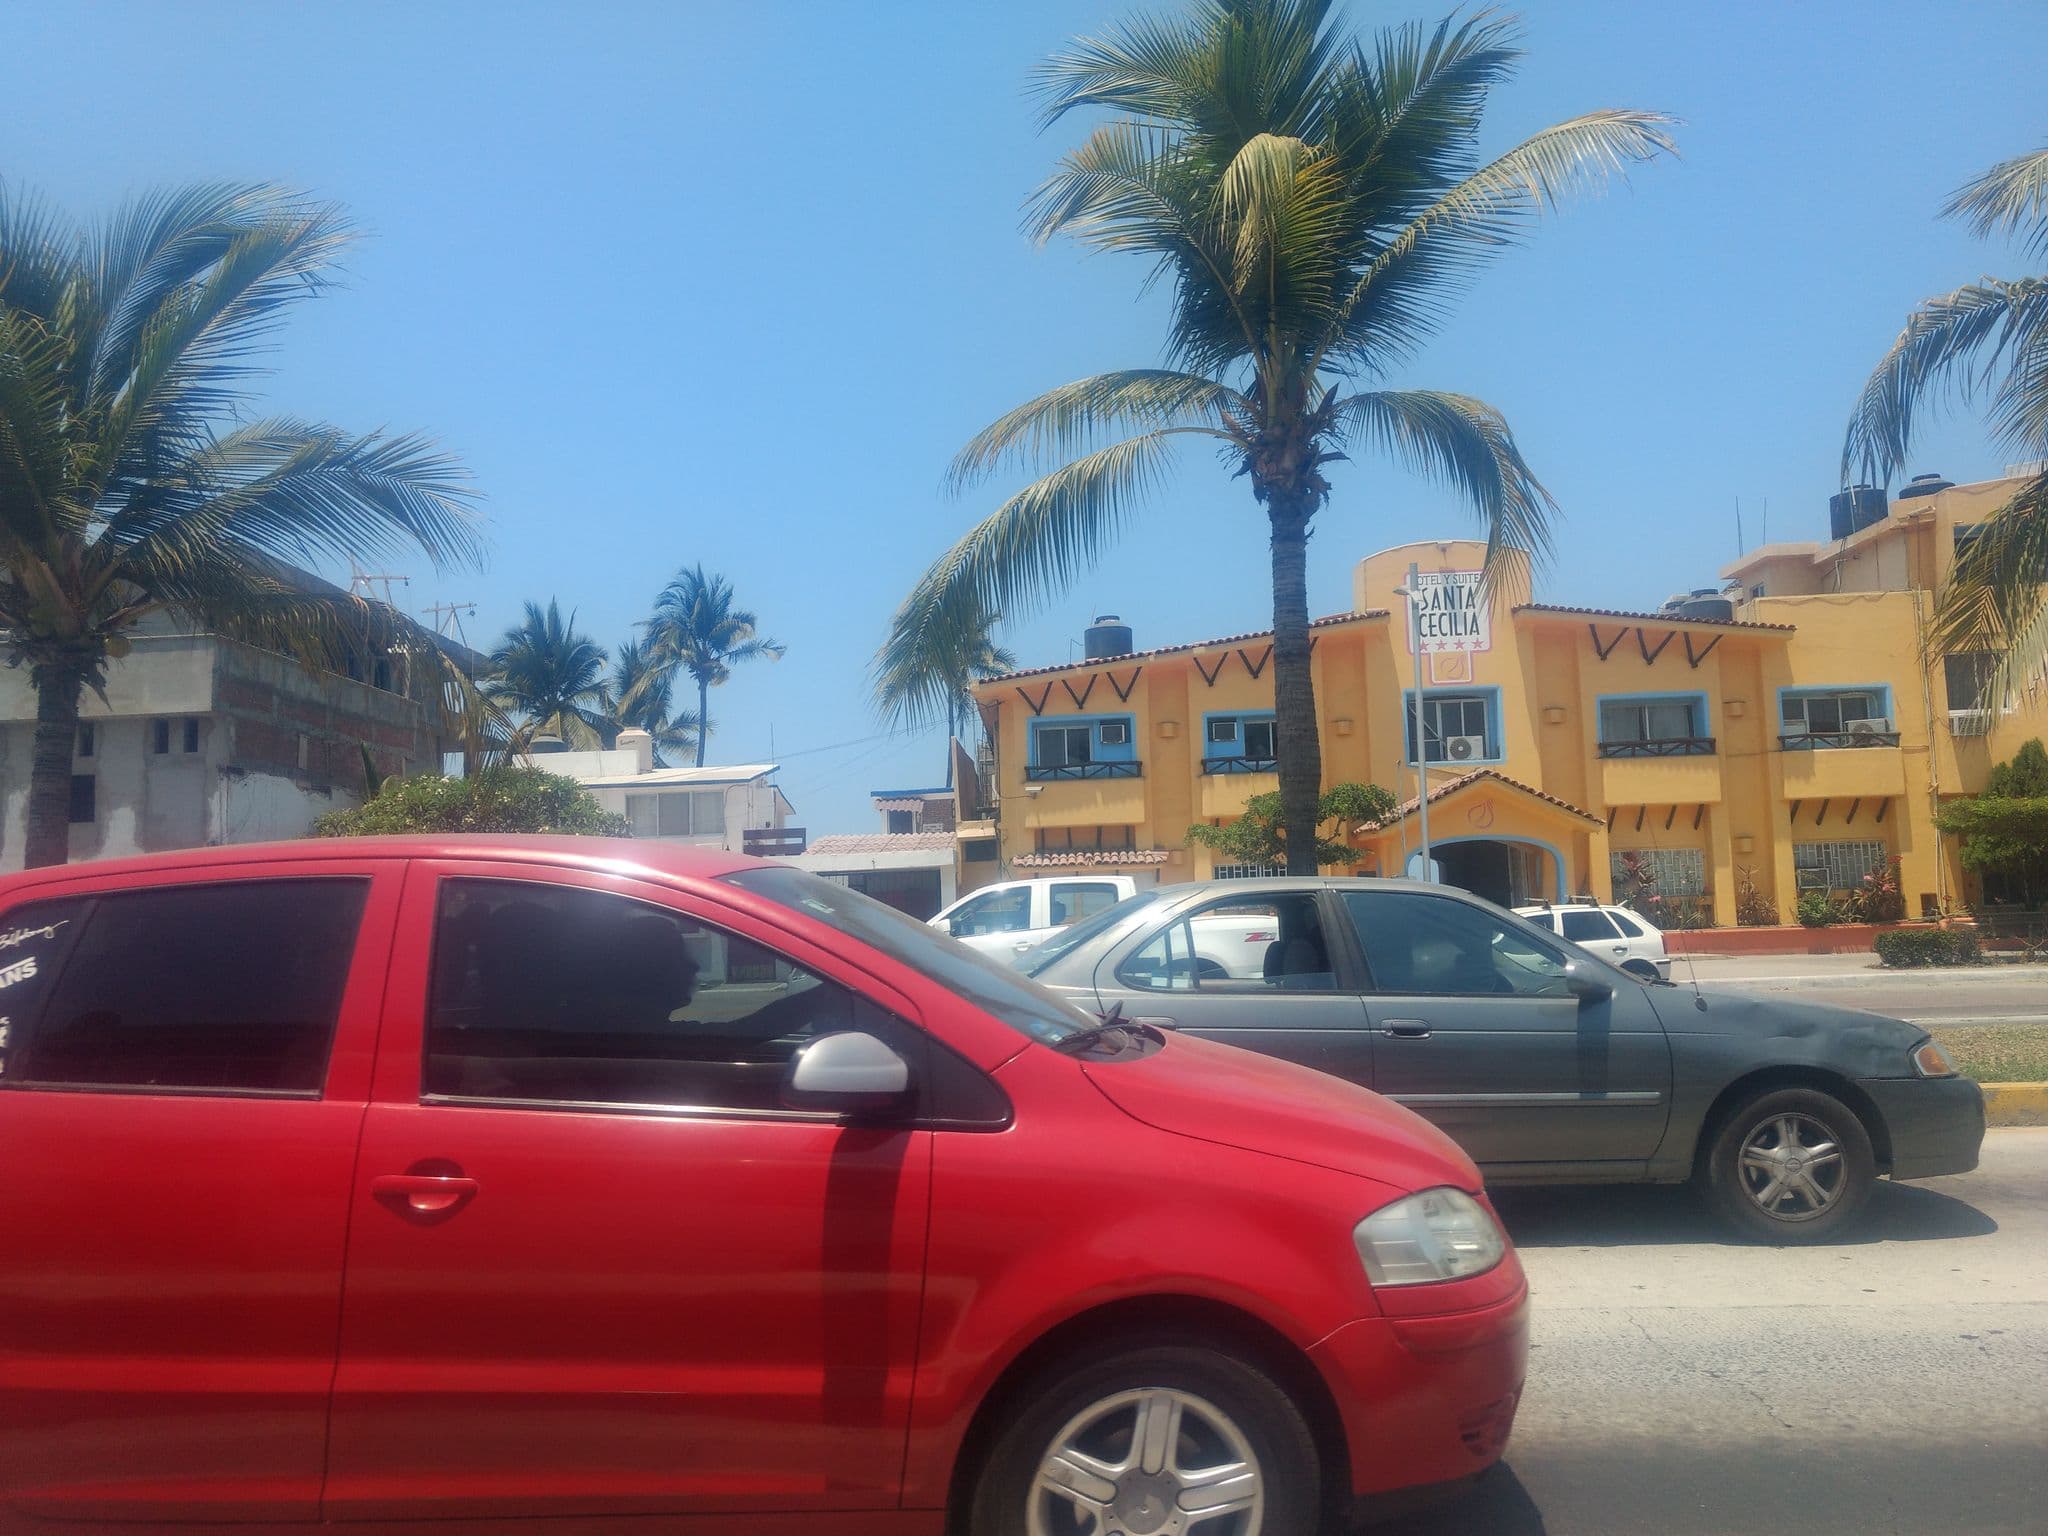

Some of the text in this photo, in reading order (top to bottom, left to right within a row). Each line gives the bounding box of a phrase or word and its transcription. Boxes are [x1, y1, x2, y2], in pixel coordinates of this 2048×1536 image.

[1417, 573, 1481, 586] OTEL Y SUITE
[1421, 585, 1476, 611] SANTA
[1420, 612, 1480, 637] CECILIA
